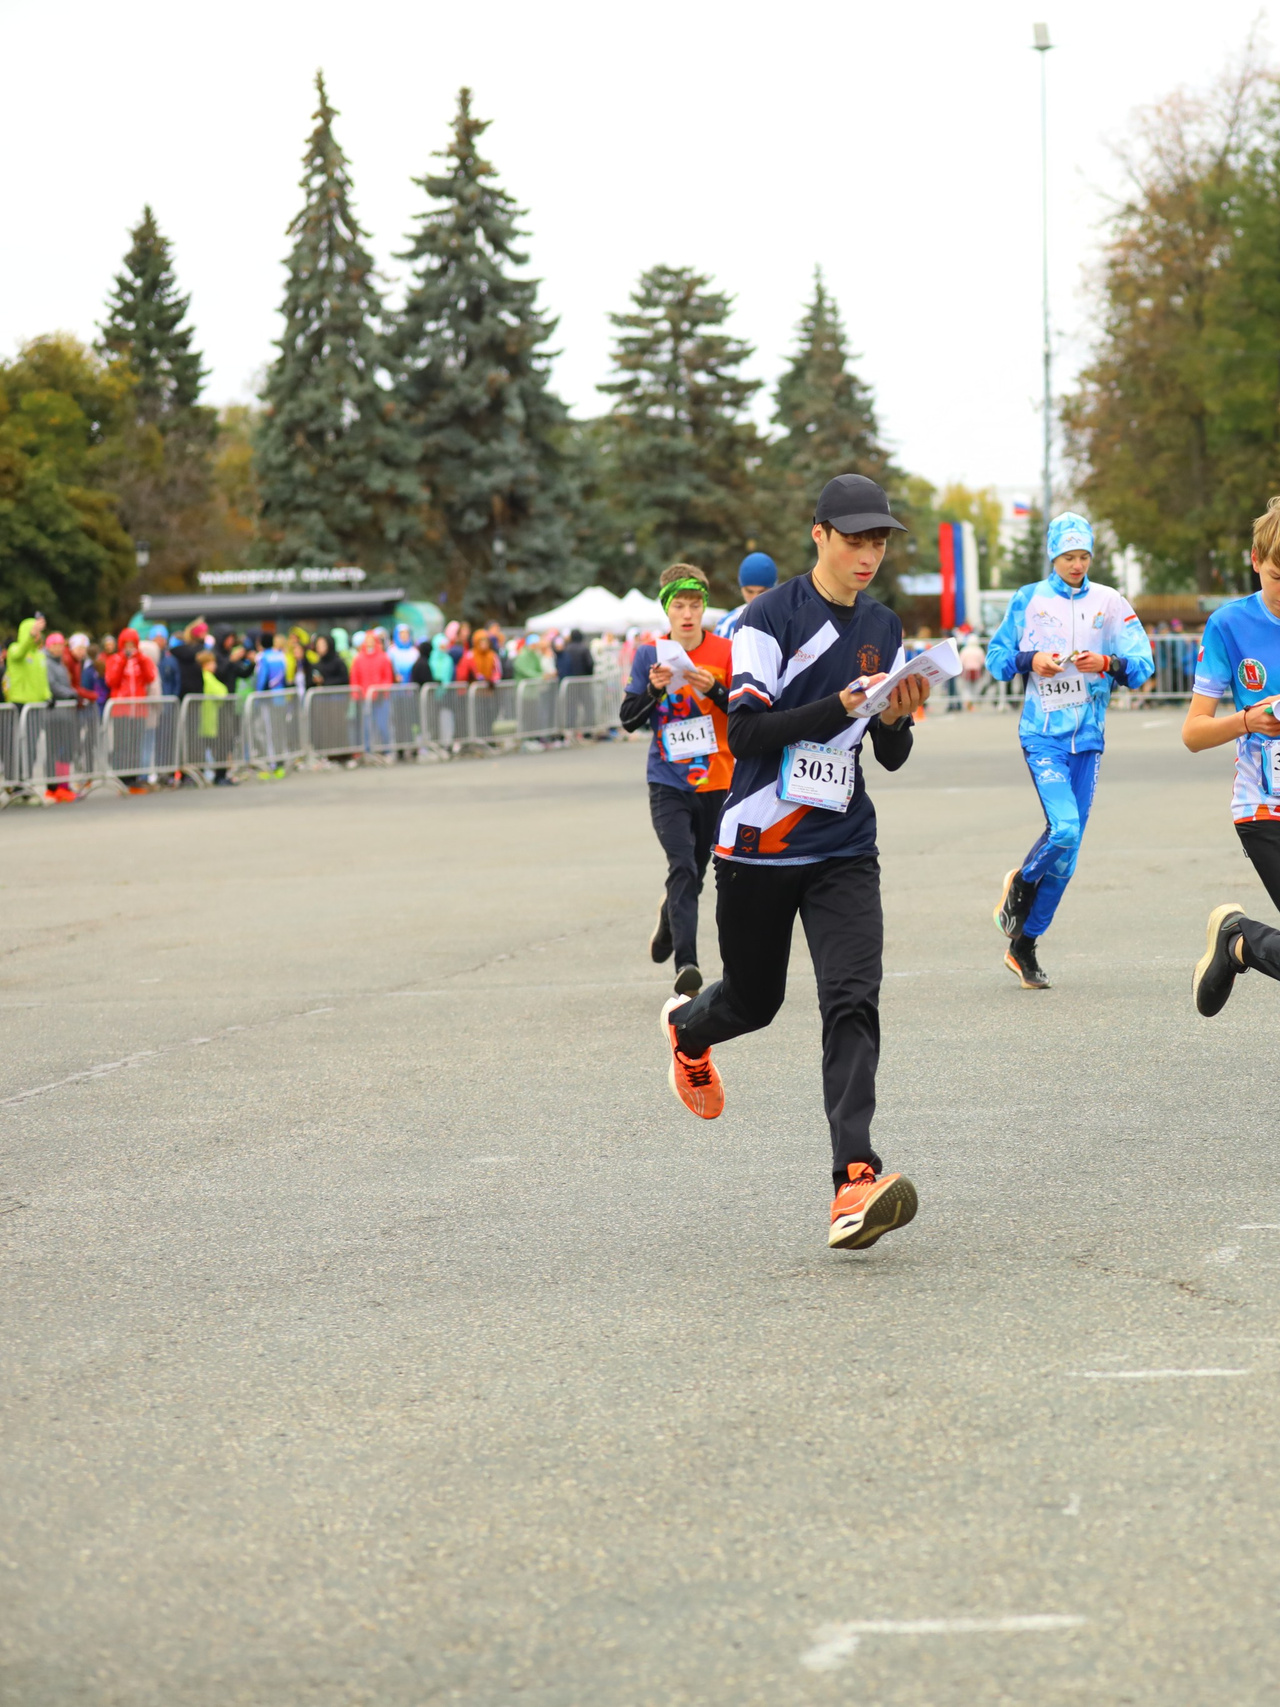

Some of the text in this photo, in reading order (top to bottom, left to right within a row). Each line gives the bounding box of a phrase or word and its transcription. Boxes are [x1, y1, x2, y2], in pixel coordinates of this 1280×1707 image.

[1045, 680, 1082, 696] 349.1
[670, 727, 706, 745] 346.1
[793, 758, 847, 785] 303.1
